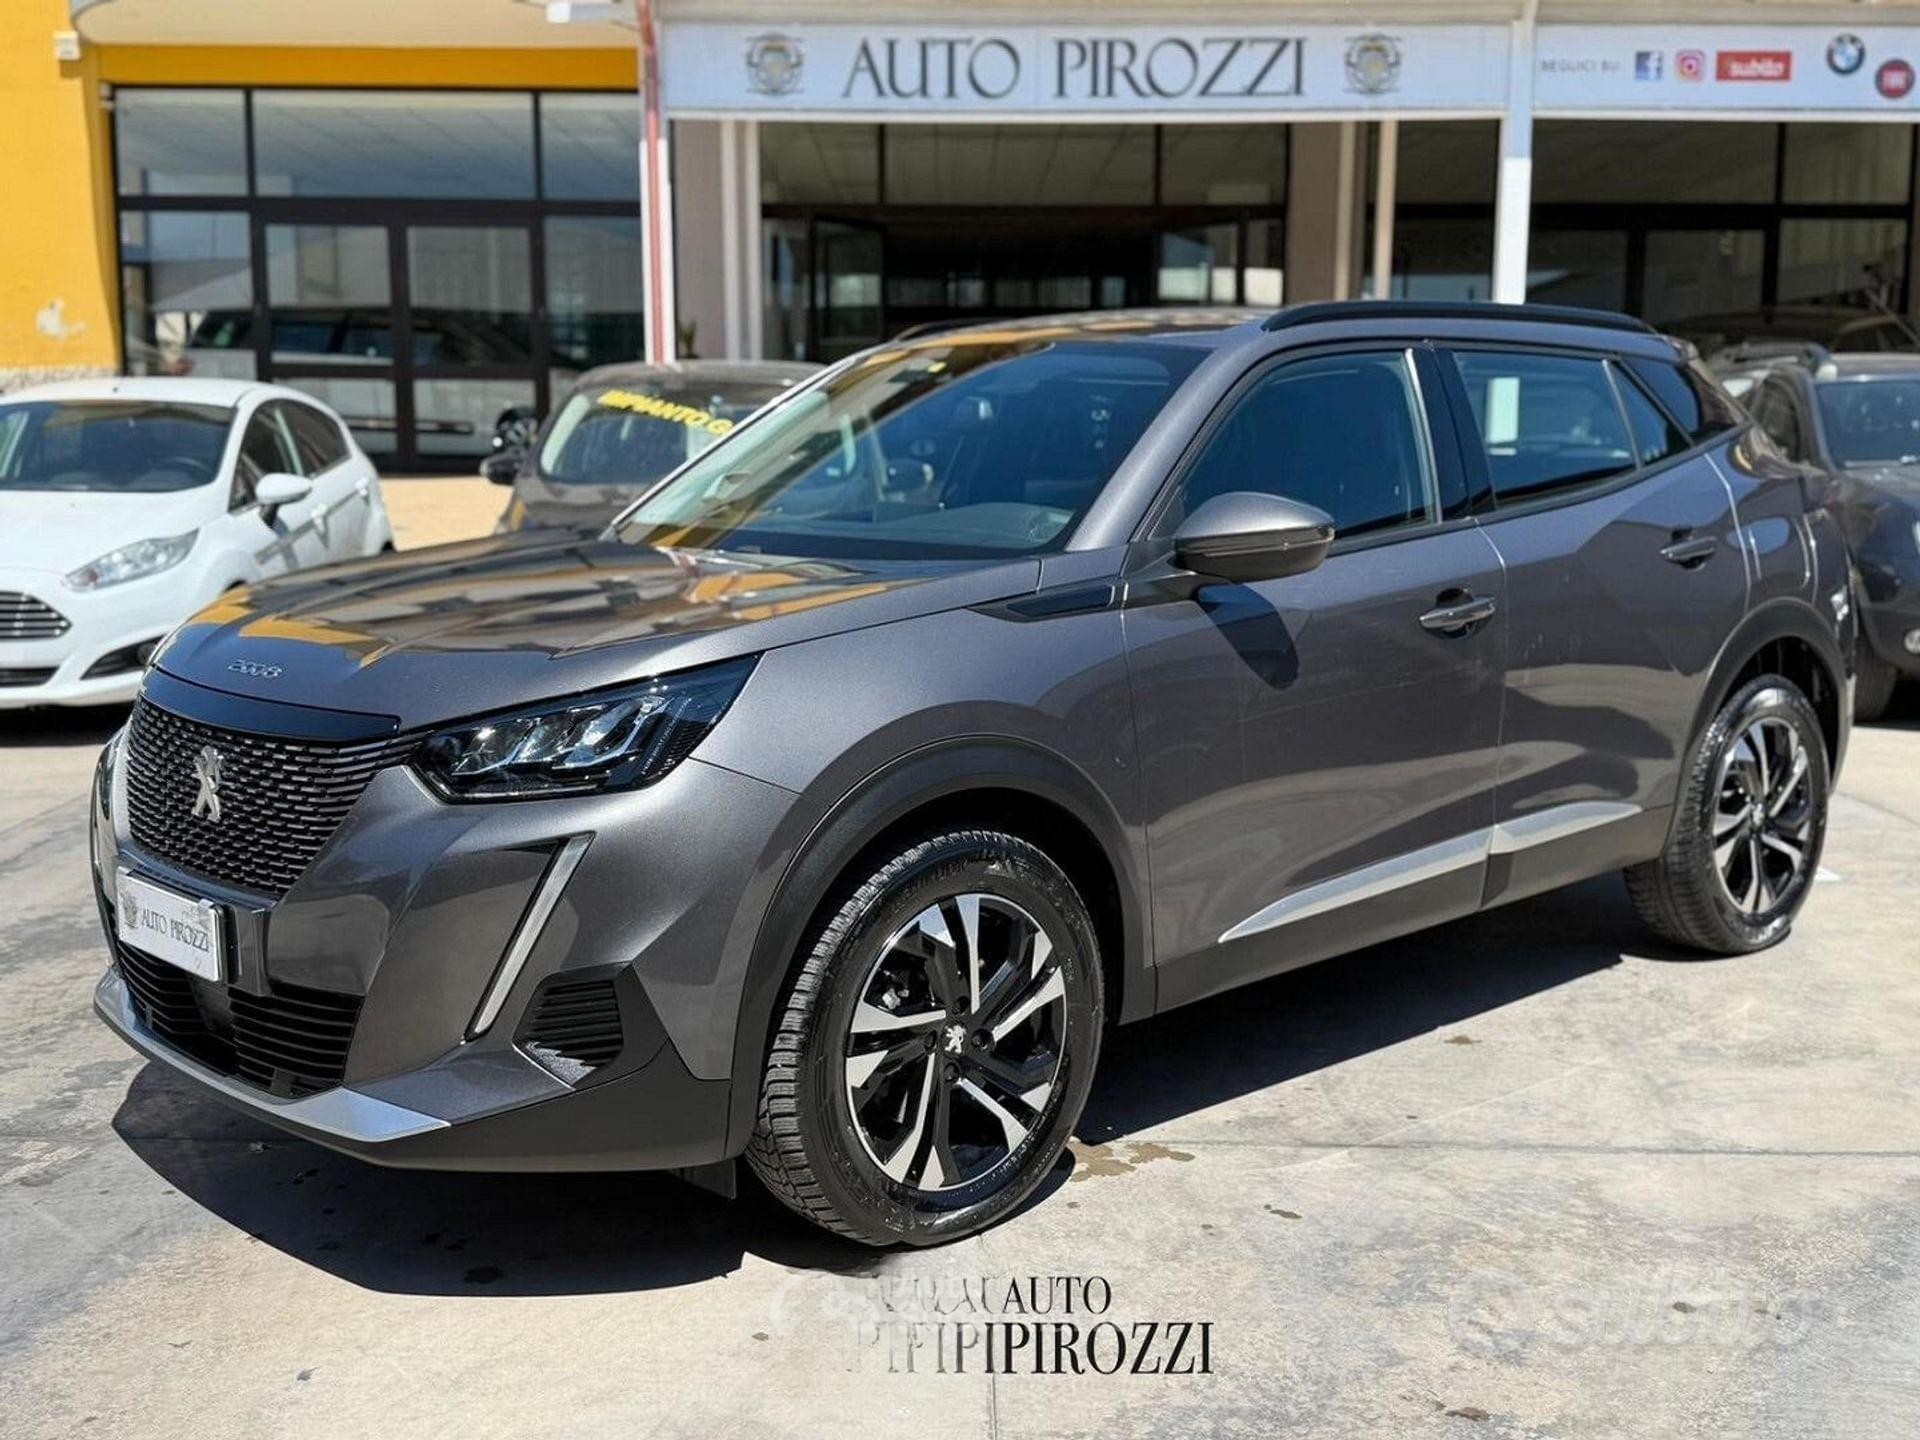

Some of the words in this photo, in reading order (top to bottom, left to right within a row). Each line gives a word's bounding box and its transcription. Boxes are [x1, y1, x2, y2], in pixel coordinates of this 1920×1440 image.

[842, 38, 1020, 99] AUTO
[1055, 37, 1309, 98] PIROZZI
[141, 909, 168, 934] AUTO
